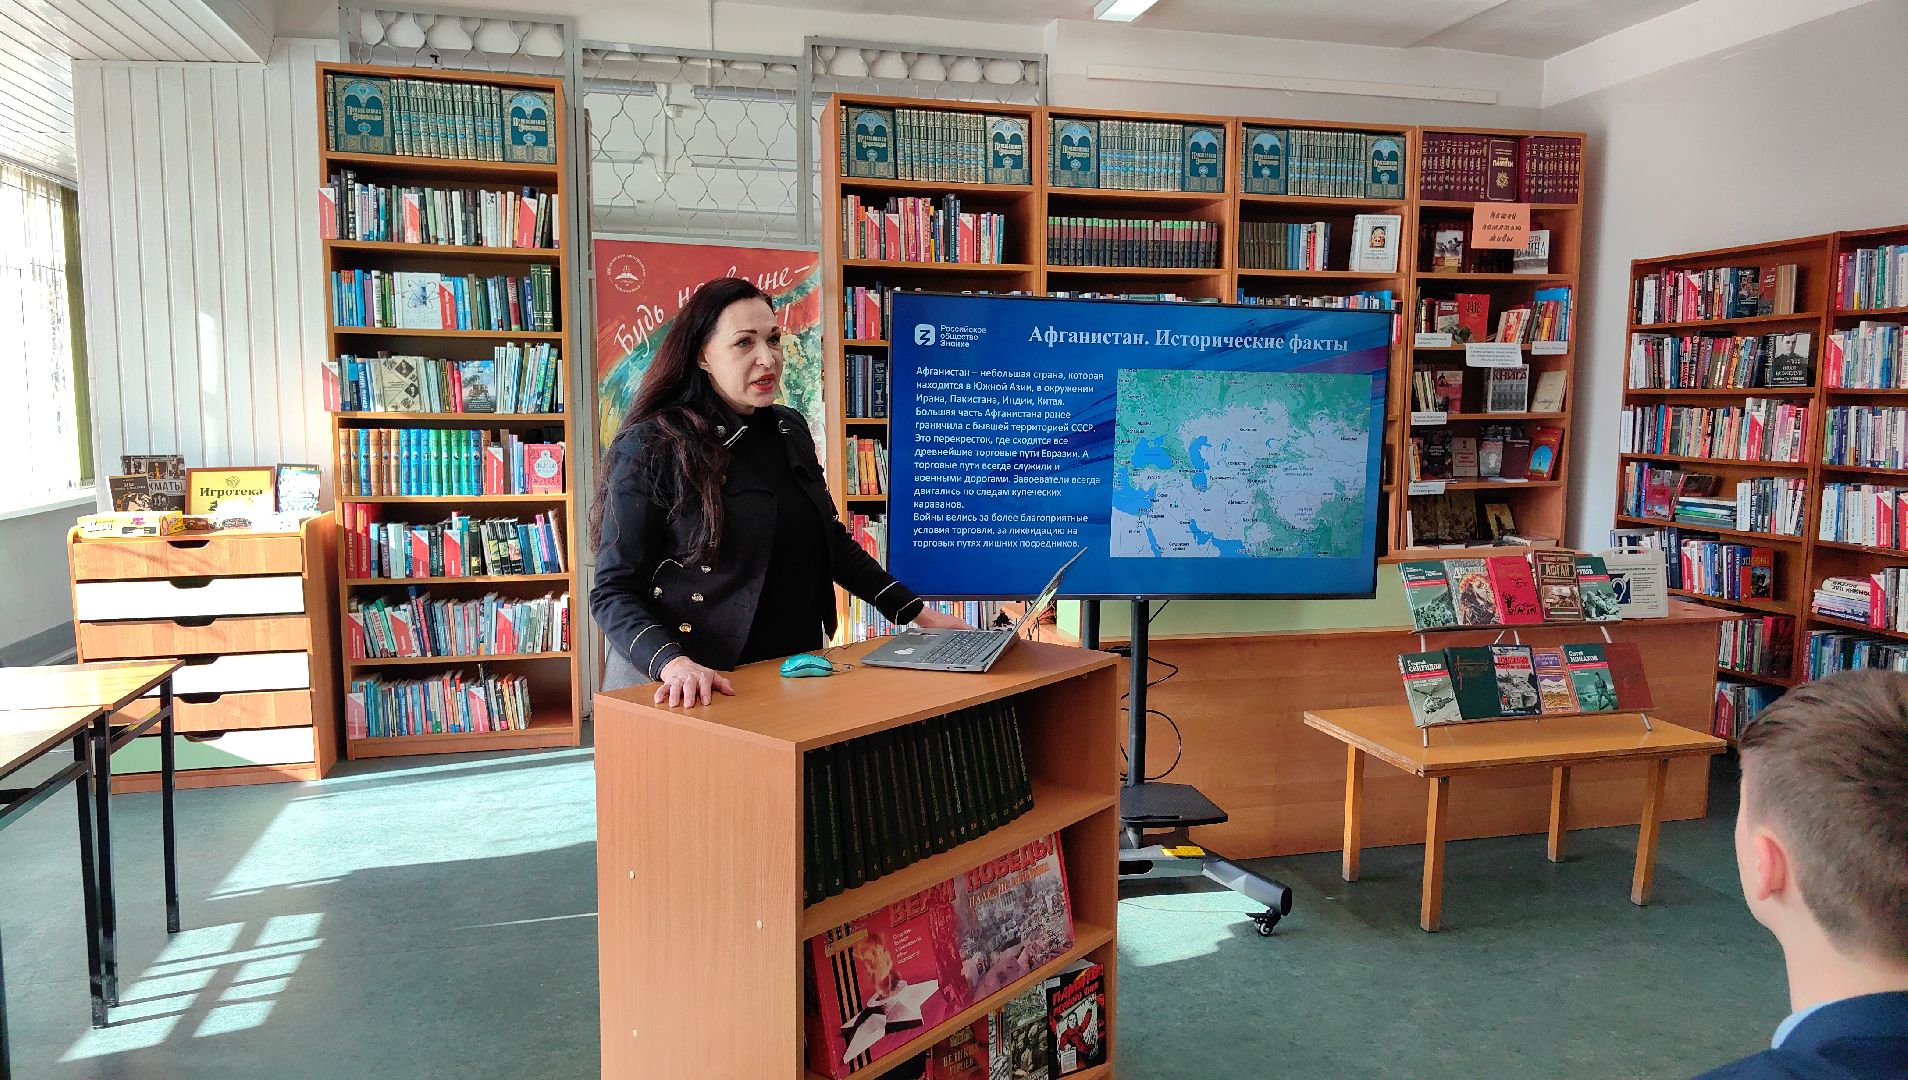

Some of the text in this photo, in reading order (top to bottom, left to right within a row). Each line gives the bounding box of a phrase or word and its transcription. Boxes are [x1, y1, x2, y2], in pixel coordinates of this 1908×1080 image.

[614, 304, 664, 356] Будь
[1029, 325, 1348, 353] Афганистан. Исторические факты
[916, 367, 969, 377] Афганистан
[980, 370, 1030, 378] небольшая
[1493, 372, 1527, 381] КНИГА
[358, 371, 366, 388] МИРА
[974, 382, 1007, 391] Южной
[1010, 383, 1034, 392] Азии,
[1044, 385, 1094, 394] окружении
[916, 394, 1064, 406] Ирана, Пакистана, Индии, Китая.
[916, 408, 955, 416] Большая
[985, 409, 1041, 419] Афганистана
[973, 422, 1008, 431] бывшей
[1011, 423, 1069, 432] территорией
[1071, 424, 1096, 432] СССР.
[934, 436, 993, 444] перекресток,
[914, 448, 972, 457] древнейшие
[976, 450, 1017, 458] торговые
[914, 462, 957, 470] торговые
[1014, 464, 1052, 472] служили
[964, 476, 1010, 484] дорогами.
[1014, 475, 1069, 484] Завоеватели
[149, 481, 183, 492] ХМАТЫ
[200, 487, 263, 498] Игротека
[976, 489, 1009, 498] следам
[1021, 514, 1088, 523] благоприятные
[1009, 528, 1064, 536] ликвидацию
[964, 836, 1052, 892] ПОБЕДЫ
